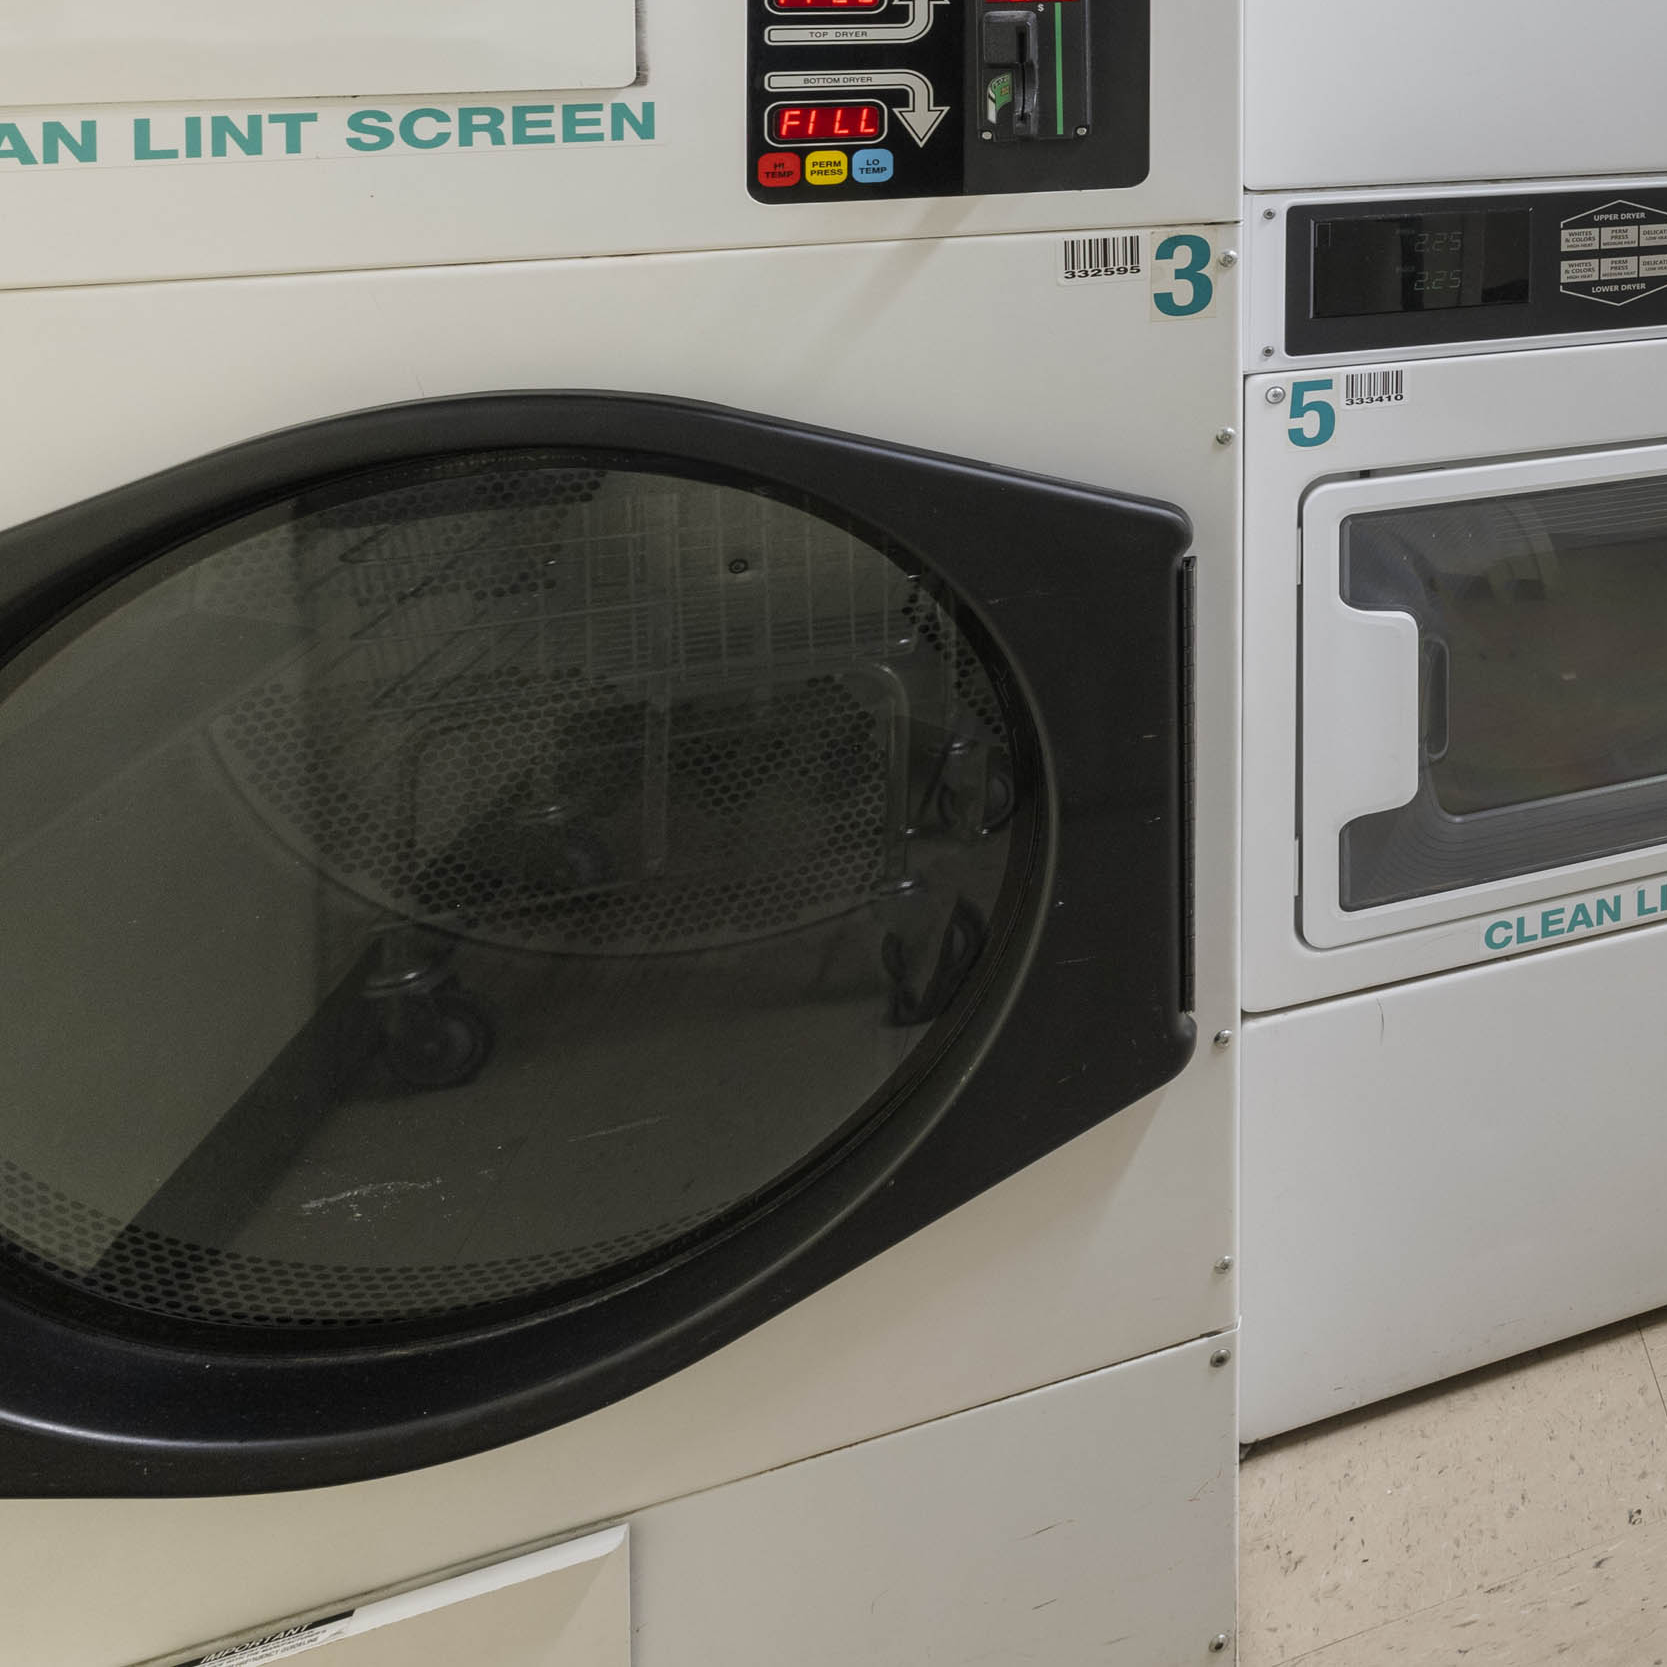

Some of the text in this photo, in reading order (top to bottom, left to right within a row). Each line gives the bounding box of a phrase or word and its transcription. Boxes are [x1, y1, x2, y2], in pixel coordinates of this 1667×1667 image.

[133, 112, 317, 160] LINT
[346, 101, 654, 152] SCREEN
[781, 109, 874, 135] FILL
[1064, 266, 1141, 279] 332595
[1153, 235, 1213, 316] 3
[1288, 379, 1335, 447] 5
[1345, 394, 1403, 406] 333410
[1484, 895, 1620, 950] CLEAN
